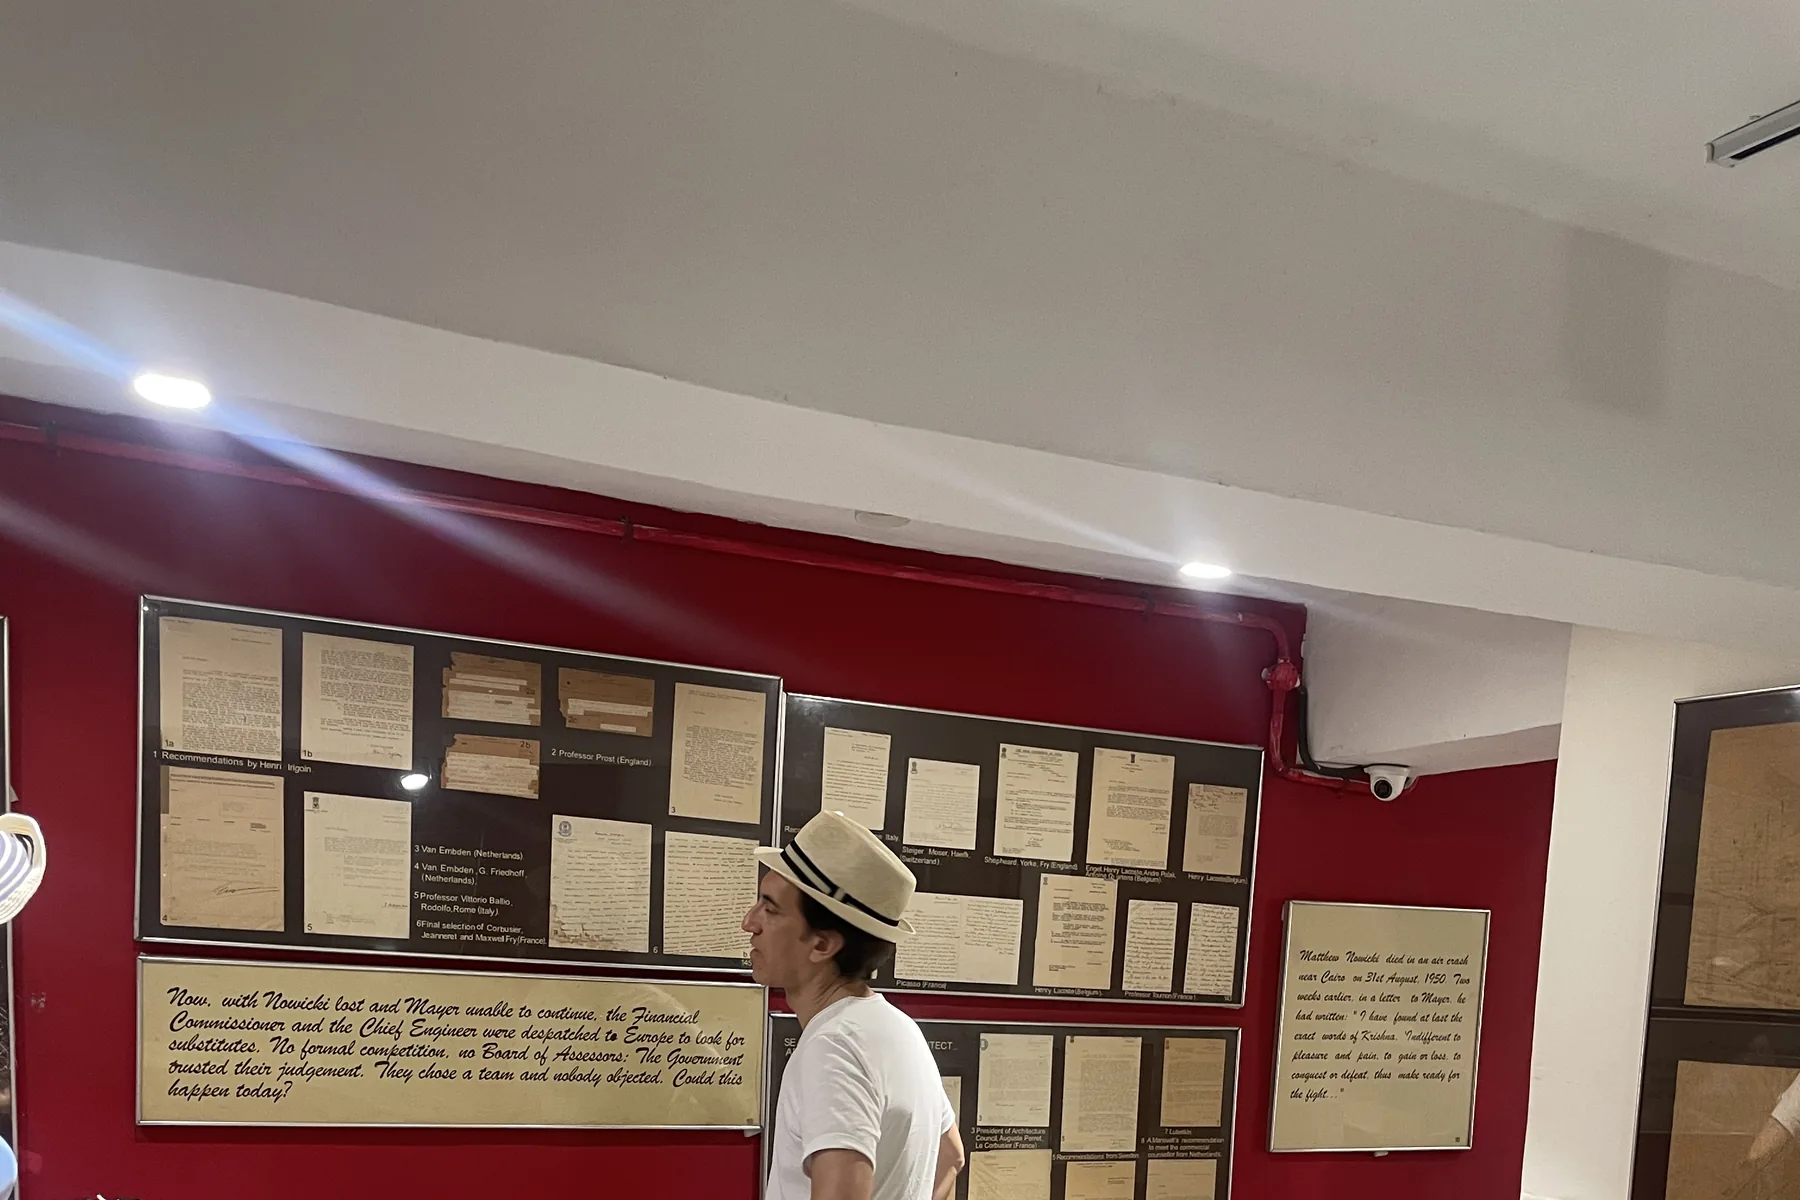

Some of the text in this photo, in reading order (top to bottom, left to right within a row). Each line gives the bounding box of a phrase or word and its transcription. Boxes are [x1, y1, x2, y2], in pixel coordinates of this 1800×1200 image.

[162, 751, 243, 766] Recommendations
[247, 760, 257, 769] by
[259, 762, 282, 770] Henri
[288, 764, 312, 773] Irigoin
[559, 750, 594, 761] Professor
[596, 754, 615, 763] Prost
[421, 845, 436, 853] Van
[439, 846, 471, 856] Embden
[422, 863, 437, 871] Van
[1040, 861, 1049, 869] Fry
[1300, 950, 1468, 966] Matthew Nowicki died in an air crash
[1299, 973, 1317, 981] near
[1321, 970, 1345, 983] Cairo
[1365, 972, 1383, 983] 31st
[1453, 974, 1470, 985] Two
[1297, 991, 1321, 1001] weeks
[1359, 994, 1367, 1002] in
[1379, 993, 1400, 1002] letter
[1411, 994, 1418, 1003] to
[1457, 995, 1466, 1004] he
[221, 991, 259, 1008] with
[263, 991, 329, 1011] Nowicki
[335, 996, 364, 1012] lost
[368, 999, 401, 1014] and
[404, 997, 459, 1021] Mayer
[465, 1001, 514, 1018] unable
[519, 1006, 531, 1018] to
[606, 1006, 627, 1022] the
[632, 1007, 700, 1024] Financial
[1296, 1010, 1312, 1020] had
[1369, 1011, 1387, 1022] have
[1393, 1012, 1417, 1024] found
[1420, 1012, 1429, 1022] at
[1432, 1011, 1447, 1022] last
[1451, 1012, 1462, 1023] the
[169, 1010, 745, 1050] Commissioner and the Chief Engineer were despatched to Europe to look for
[1294, 1032, 1315, 1041] exact
[1322, 1031, 1346, 1040] words
[1350, 1031, 1358, 1043] of
[1453, 1034, 1461, 1042] to
[169, 1034, 260, 1053] substitutes.
[270, 1036, 295, 1054] No
[300, 1040, 356, 1060] formal
[459, 1049, 475, 1059] no
[482, 1043, 528, 1061] Board
[534, 1048, 548, 1065] of
[636, 1047, 661, 1064] The
[667, 1048, 743, 1067] Government
[1292, 1050, 1328, 1062] pleasure
[1335, 1050, 1350, 1060] and
[1384, 1052, 1391, 1060] to
[1399, 1053, 1416, 1063] gain
[1453, 1053, 1461, 1061] to
[168, 1058, 743, 1087] trusted their judgement. They chose a team and nobody objected. Could this
[1292, 1071, 1326, 1083] conquest
[1374, 1070, 1391, 1080] thus
[1398, 1070, 1419, 1080] make
[1423, 1070, 1445, 1082] ready
[1448, 1071, 1460, 1082] for
[168, 1079, 292, 1102] happen today?
[1290, 1088, 1302, 1099] the
